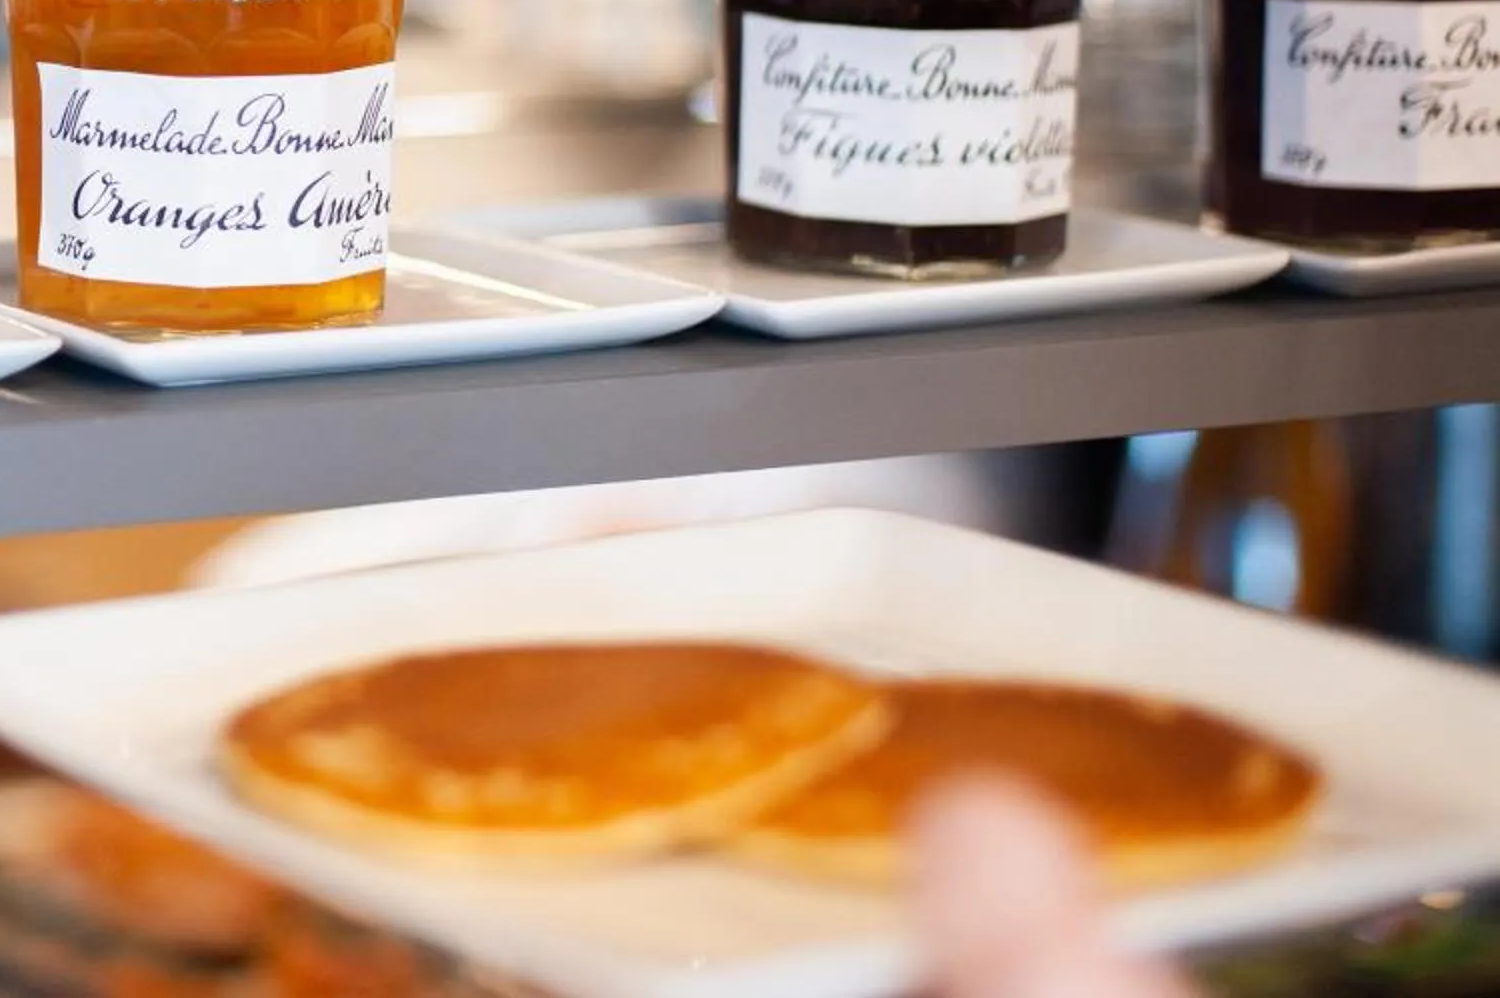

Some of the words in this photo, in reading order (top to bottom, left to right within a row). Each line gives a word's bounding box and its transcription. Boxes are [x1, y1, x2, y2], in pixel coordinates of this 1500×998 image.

[762, 33, 894, 110] Confiture
[905, 42, 1017, 103] Bonne
[1287, 11, 1430, 84] Confiture
[49, 88, 228, 156] Marmelade
[231, 92, 344, 156] Bonne
[776, 106, 946, 178] Figues
[1398, 77, 1500, 142] Fra
[71, 169, 268, 250] Oranges
[56, 232, 96, 272] 370g
